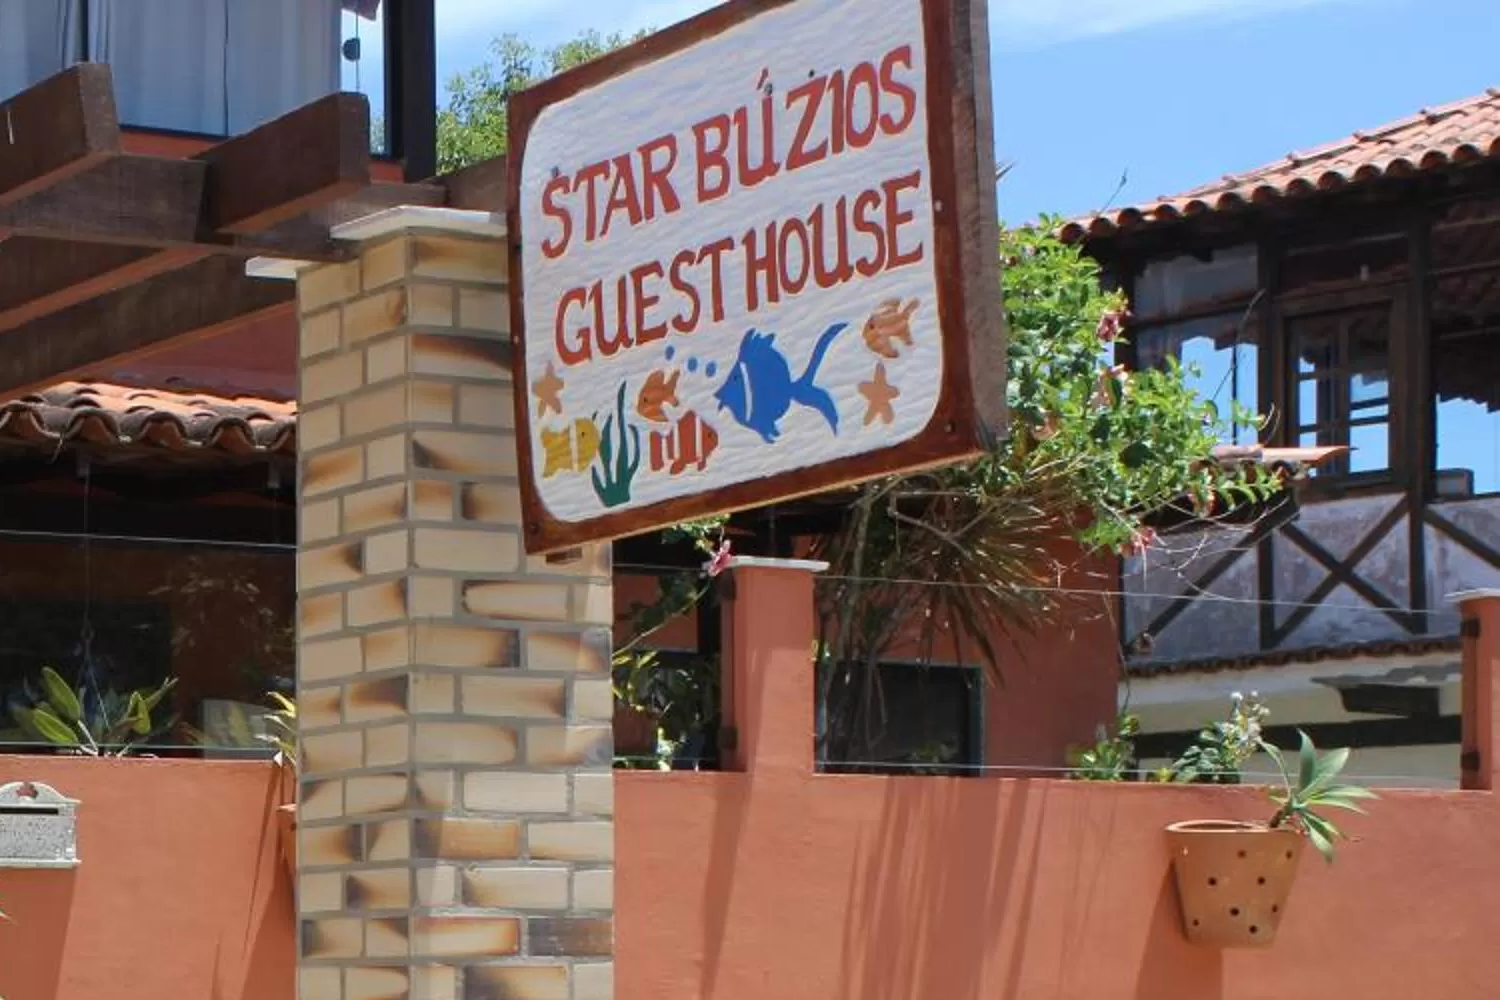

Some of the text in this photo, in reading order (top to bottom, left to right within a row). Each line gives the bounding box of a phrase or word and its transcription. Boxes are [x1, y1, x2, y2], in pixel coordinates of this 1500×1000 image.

[541, 45, 918, 259] STAR BÚZIOS
[555, 170, 924, 365] GUEST HOUSE
